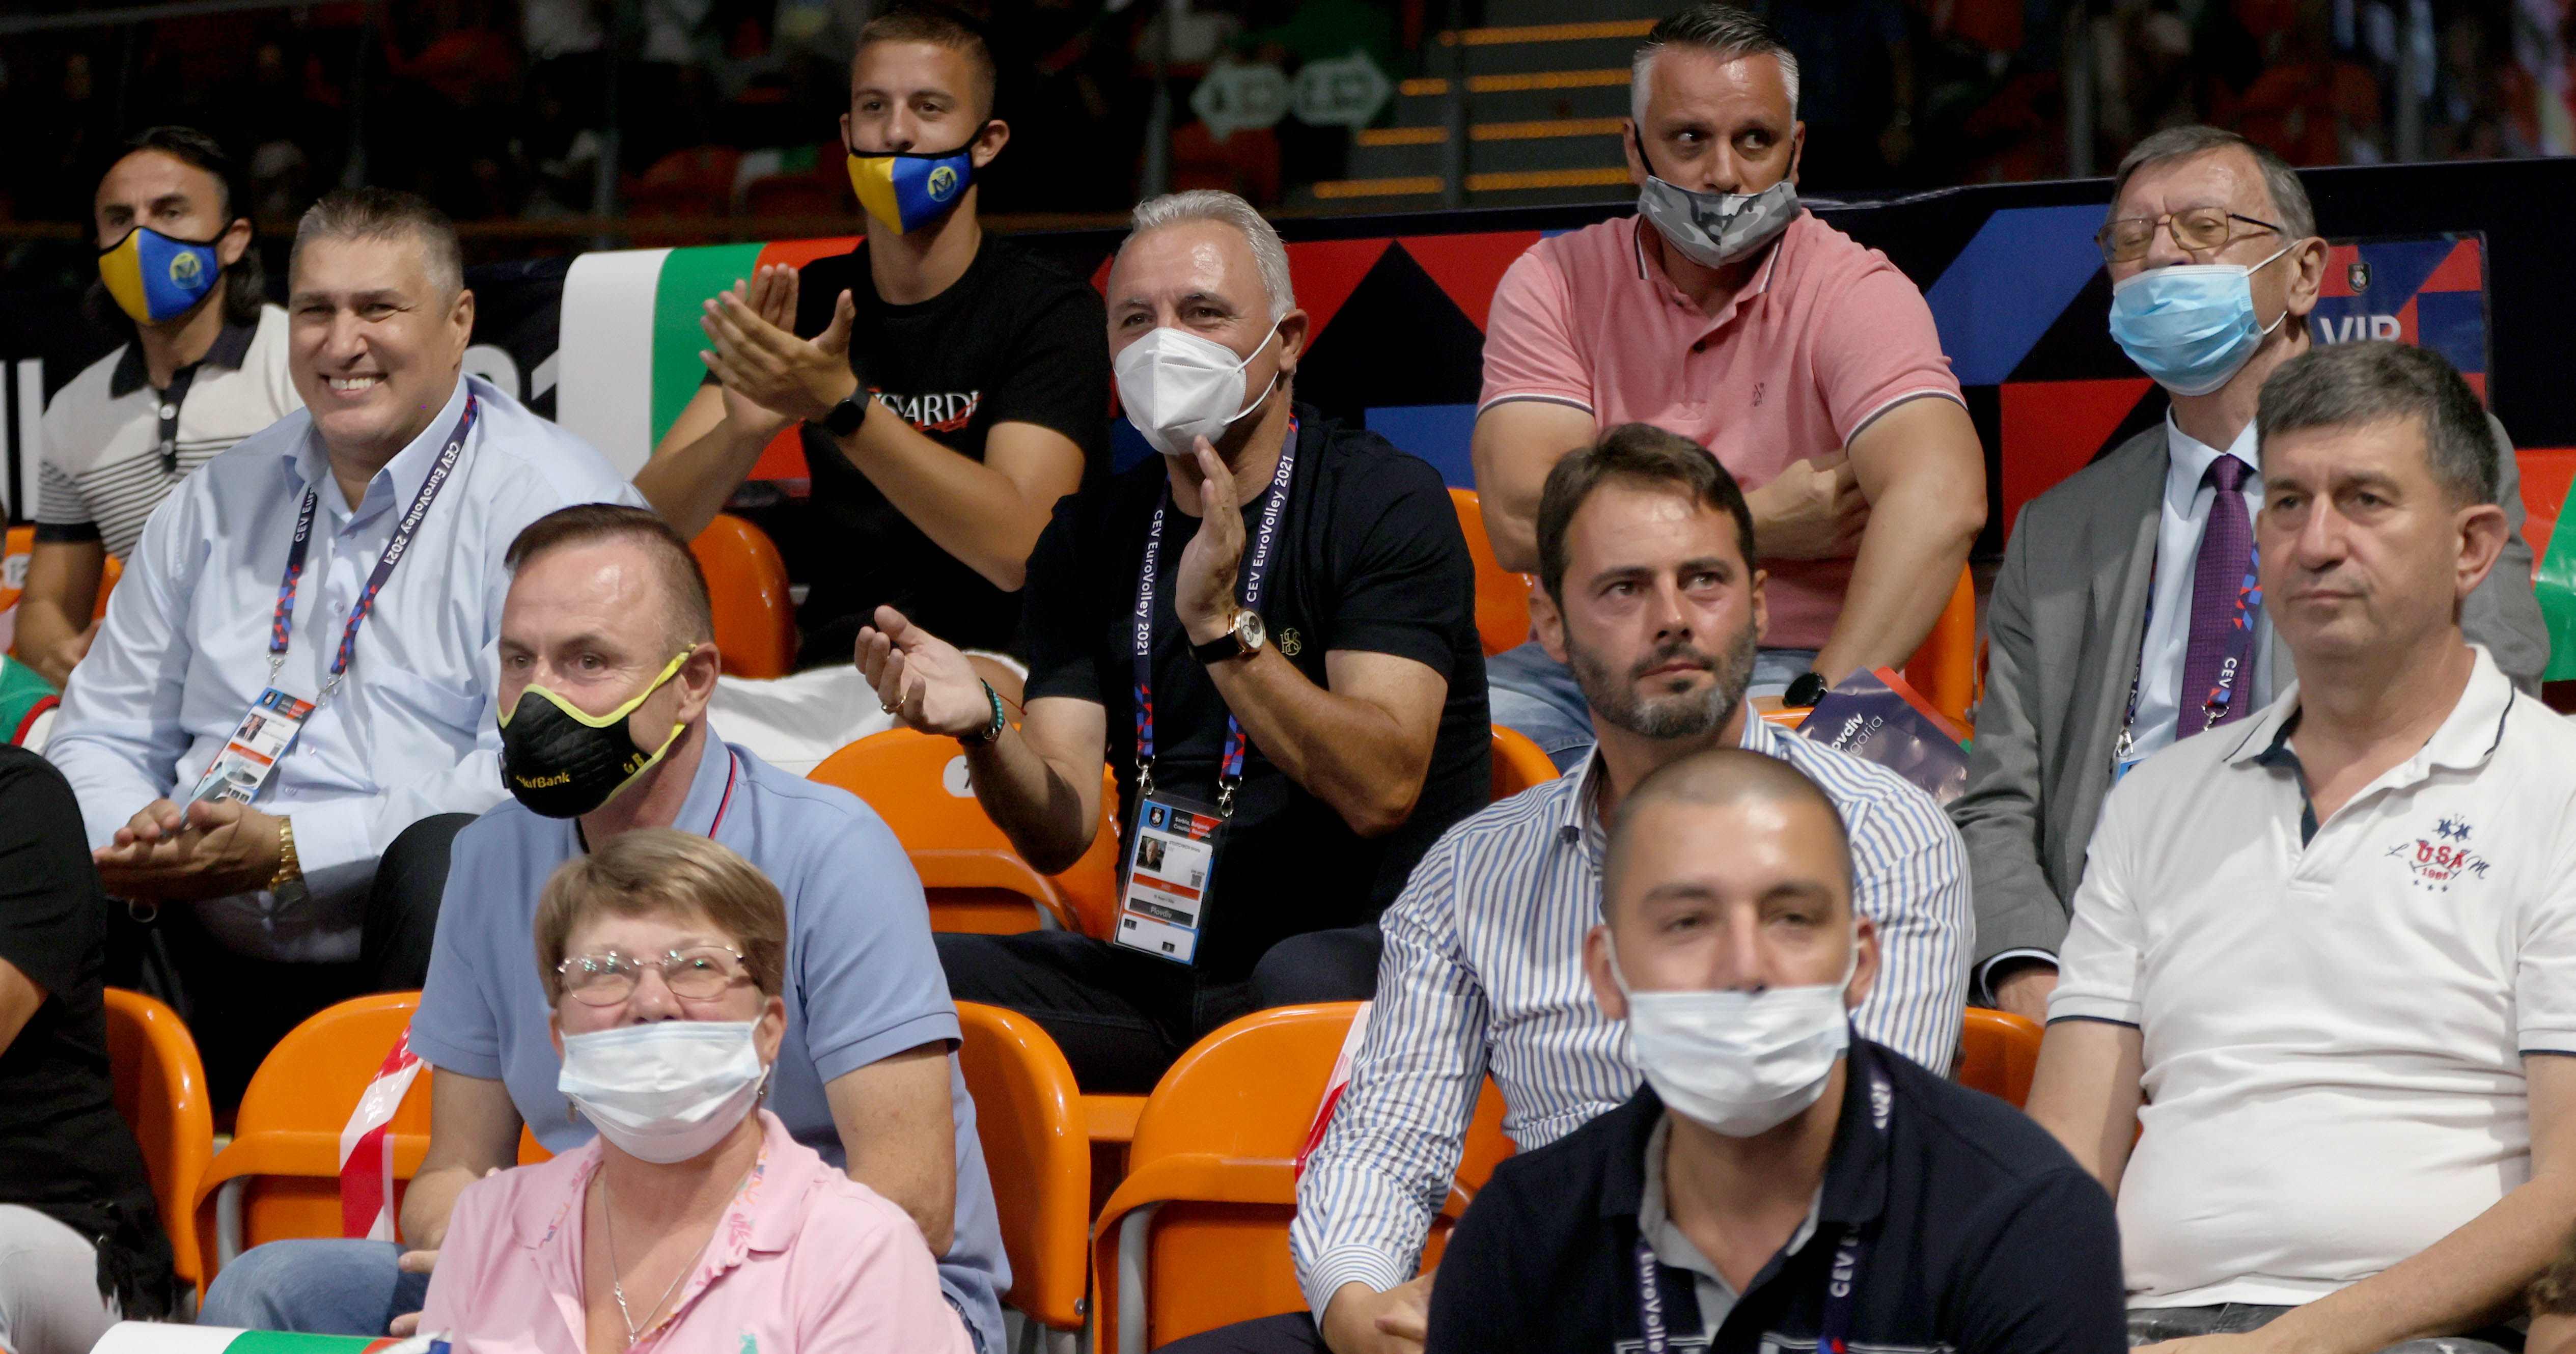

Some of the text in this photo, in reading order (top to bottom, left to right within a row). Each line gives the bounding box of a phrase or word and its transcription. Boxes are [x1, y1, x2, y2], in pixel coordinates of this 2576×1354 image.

[2319, 314, 2402, 344] VIP
[295, 517, 310, 542] CEV
[383, 442, 459, 565] CEV EuroVolley 2021
[1247, 455, 1294, 602] CEV EuroVolley 2021
[1136, 510, 1163, 656] CEV EuroVolley 2021
[2219, 657, 2237, 688] CEV
[2416, 839, 2470, 870] USA
[1640, 1252, 1667, 1354] EuroVolle
